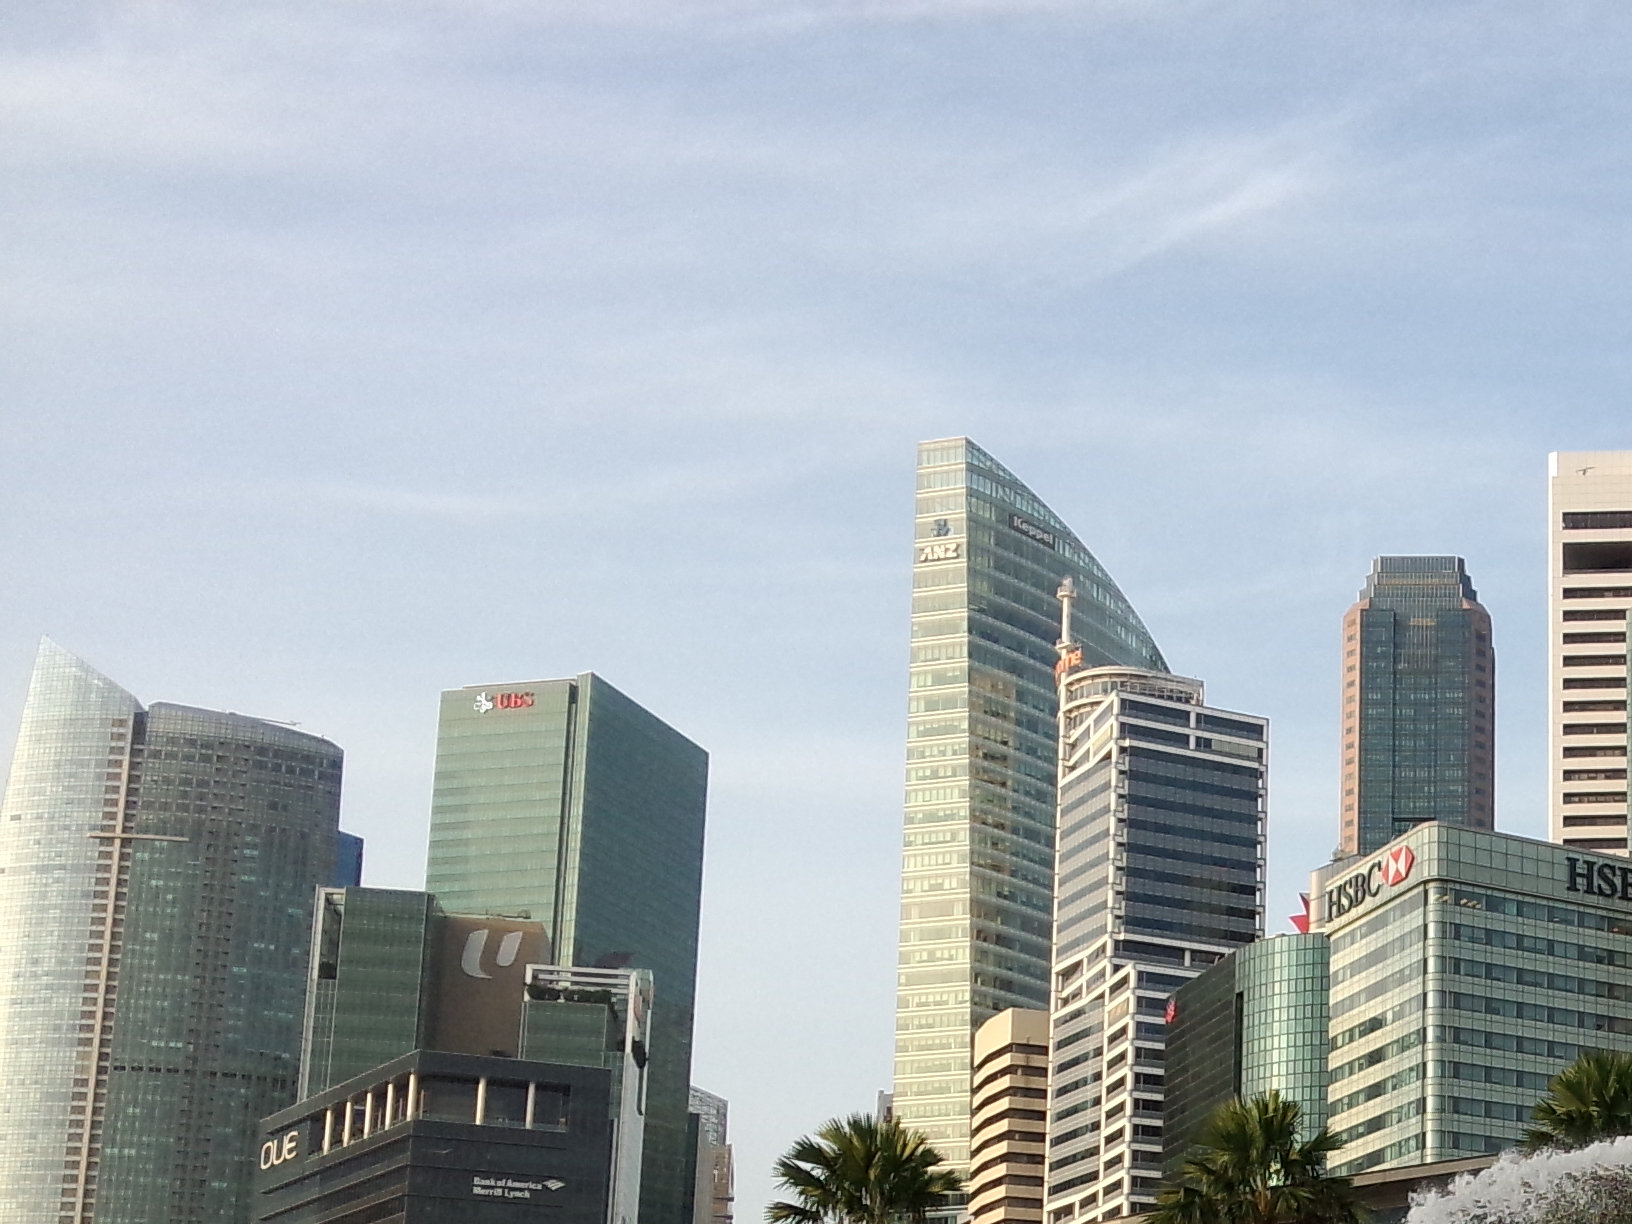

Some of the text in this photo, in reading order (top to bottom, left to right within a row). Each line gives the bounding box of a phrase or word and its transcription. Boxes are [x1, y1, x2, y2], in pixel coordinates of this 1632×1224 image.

[1013, 515, 1054, 544] Keppel
[919, 543, 960, 562] ANZ
[496, 692, 534, 709] UBS
[1325, 860, 1381, 923] HSBC
[260, 1131, 299, 1170] OUE
[472, 1186, 530, 1199] Merrill Lynch
[473, 1176, 543, 1190] Bank of America
